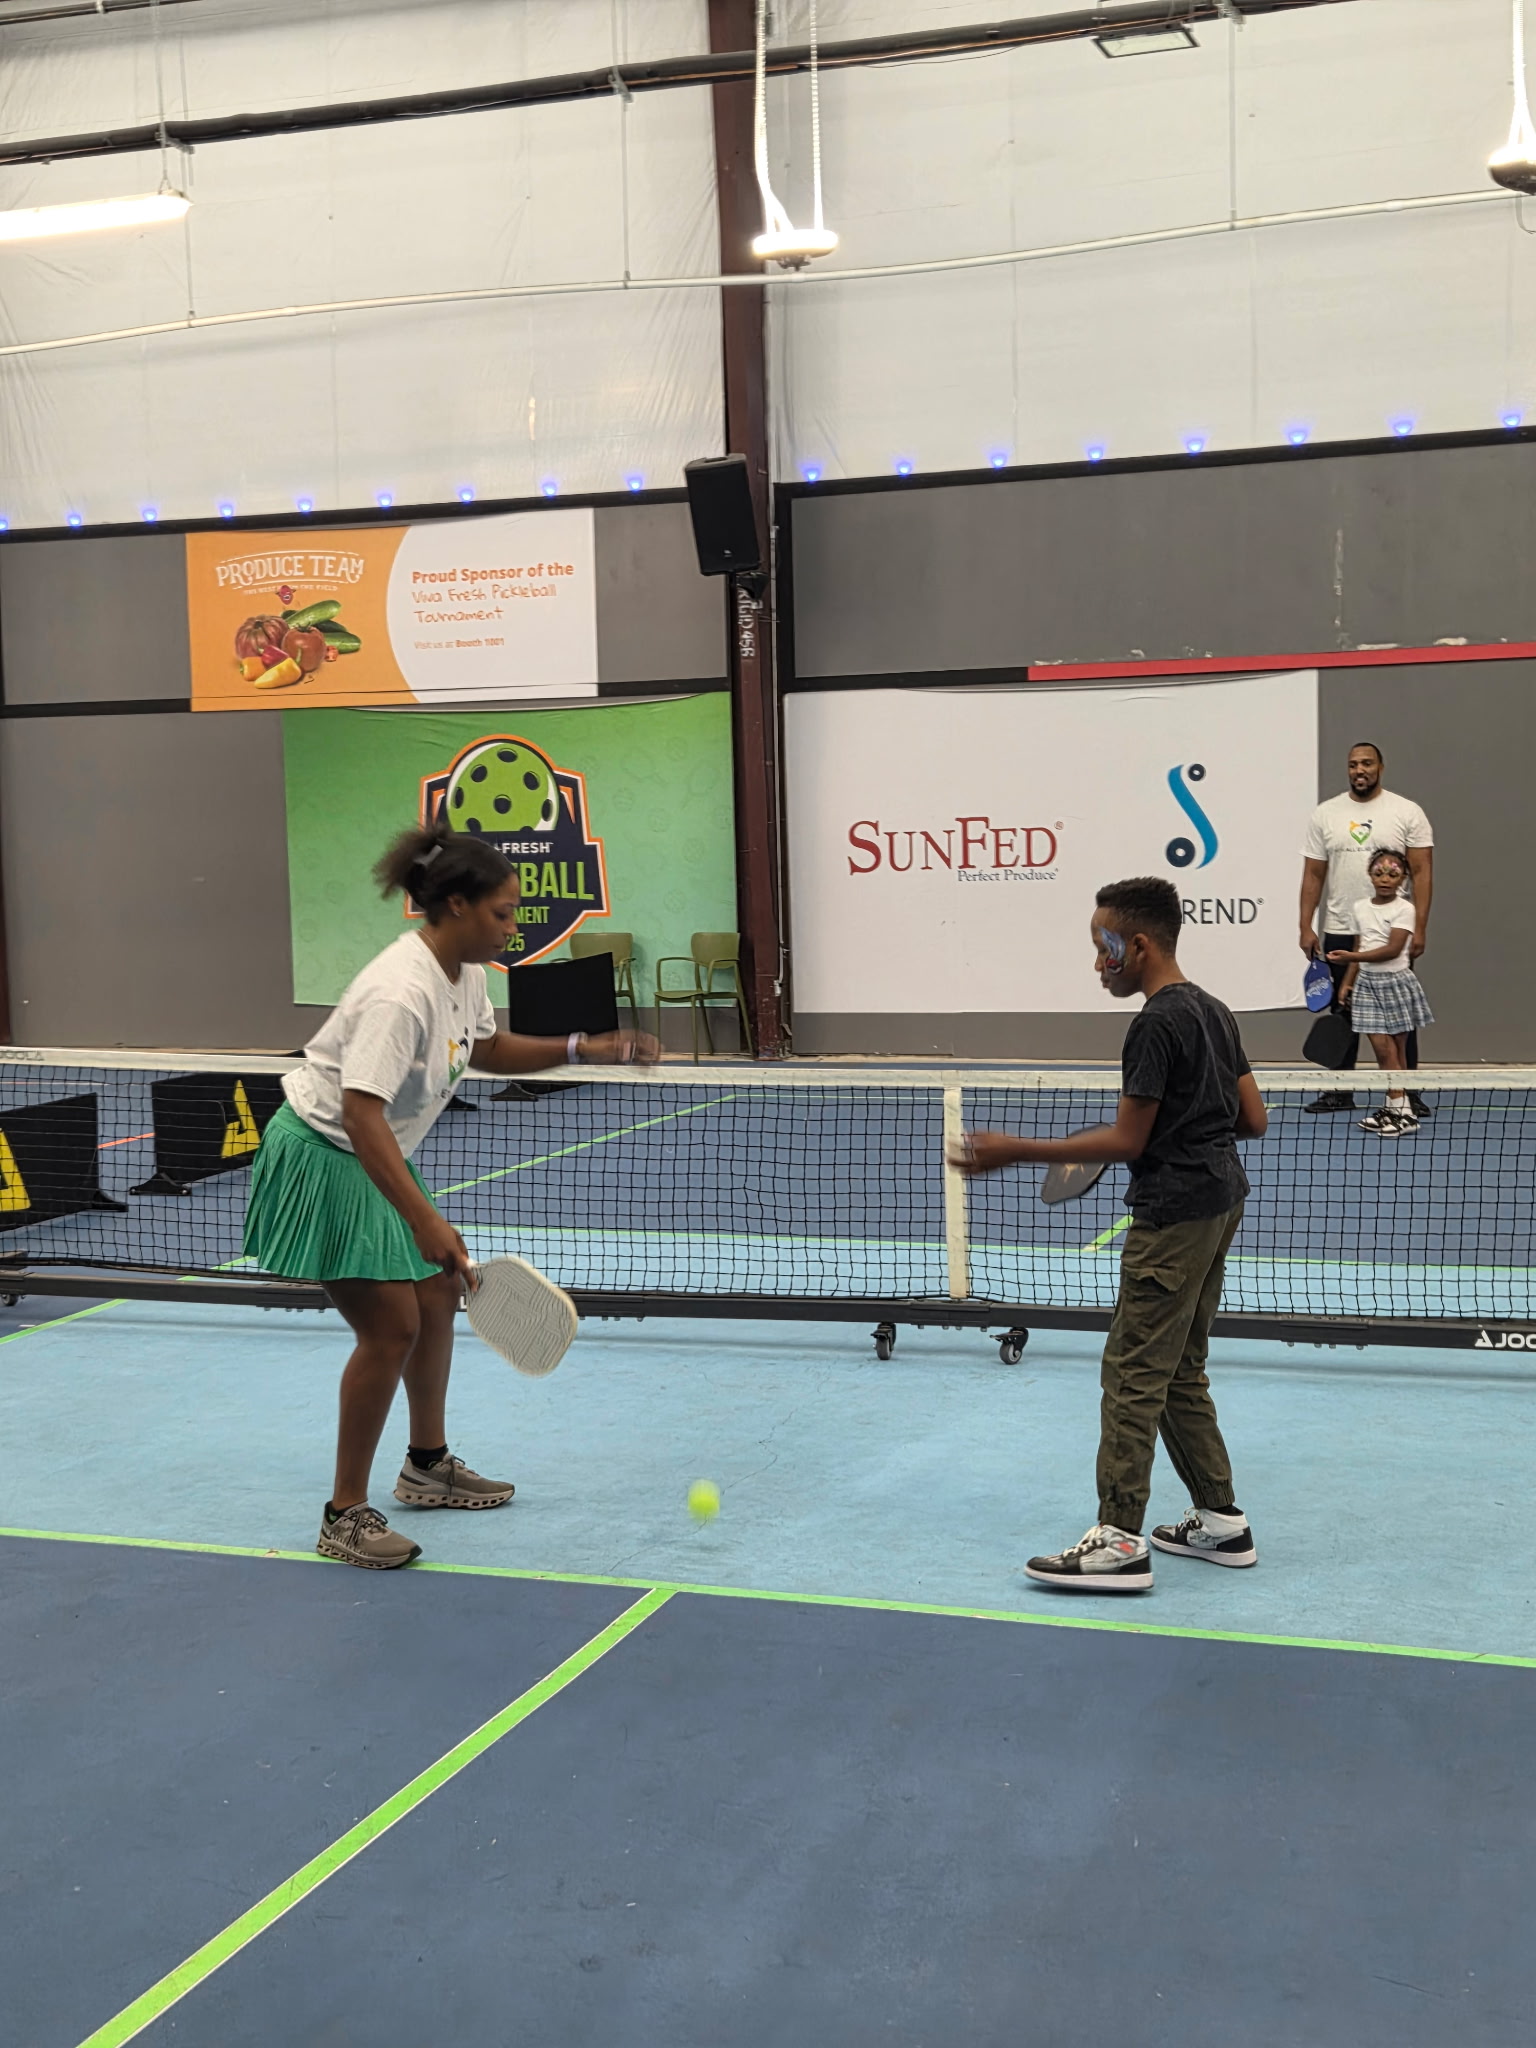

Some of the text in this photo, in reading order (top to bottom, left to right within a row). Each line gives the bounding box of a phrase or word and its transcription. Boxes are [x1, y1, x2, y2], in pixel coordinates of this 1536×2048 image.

[215, 555, 365, 587] PRODUCE TEAM
[411, 562, 574, 584] Proud Sponsor of the
[411, 582, 557, 604] Viva Fresh Pickleball
[413, 606, 504, 623] Tournament
[502, 842, 551, 854] FRESH
[511, 861, 595, 900] BALL
[957, 869, 1057, 882] Perfect Produce
[513, 906, 550, 924] MENT
[1181, 898, 1257, 924] REND
[502, 932, 525, 952] 25
